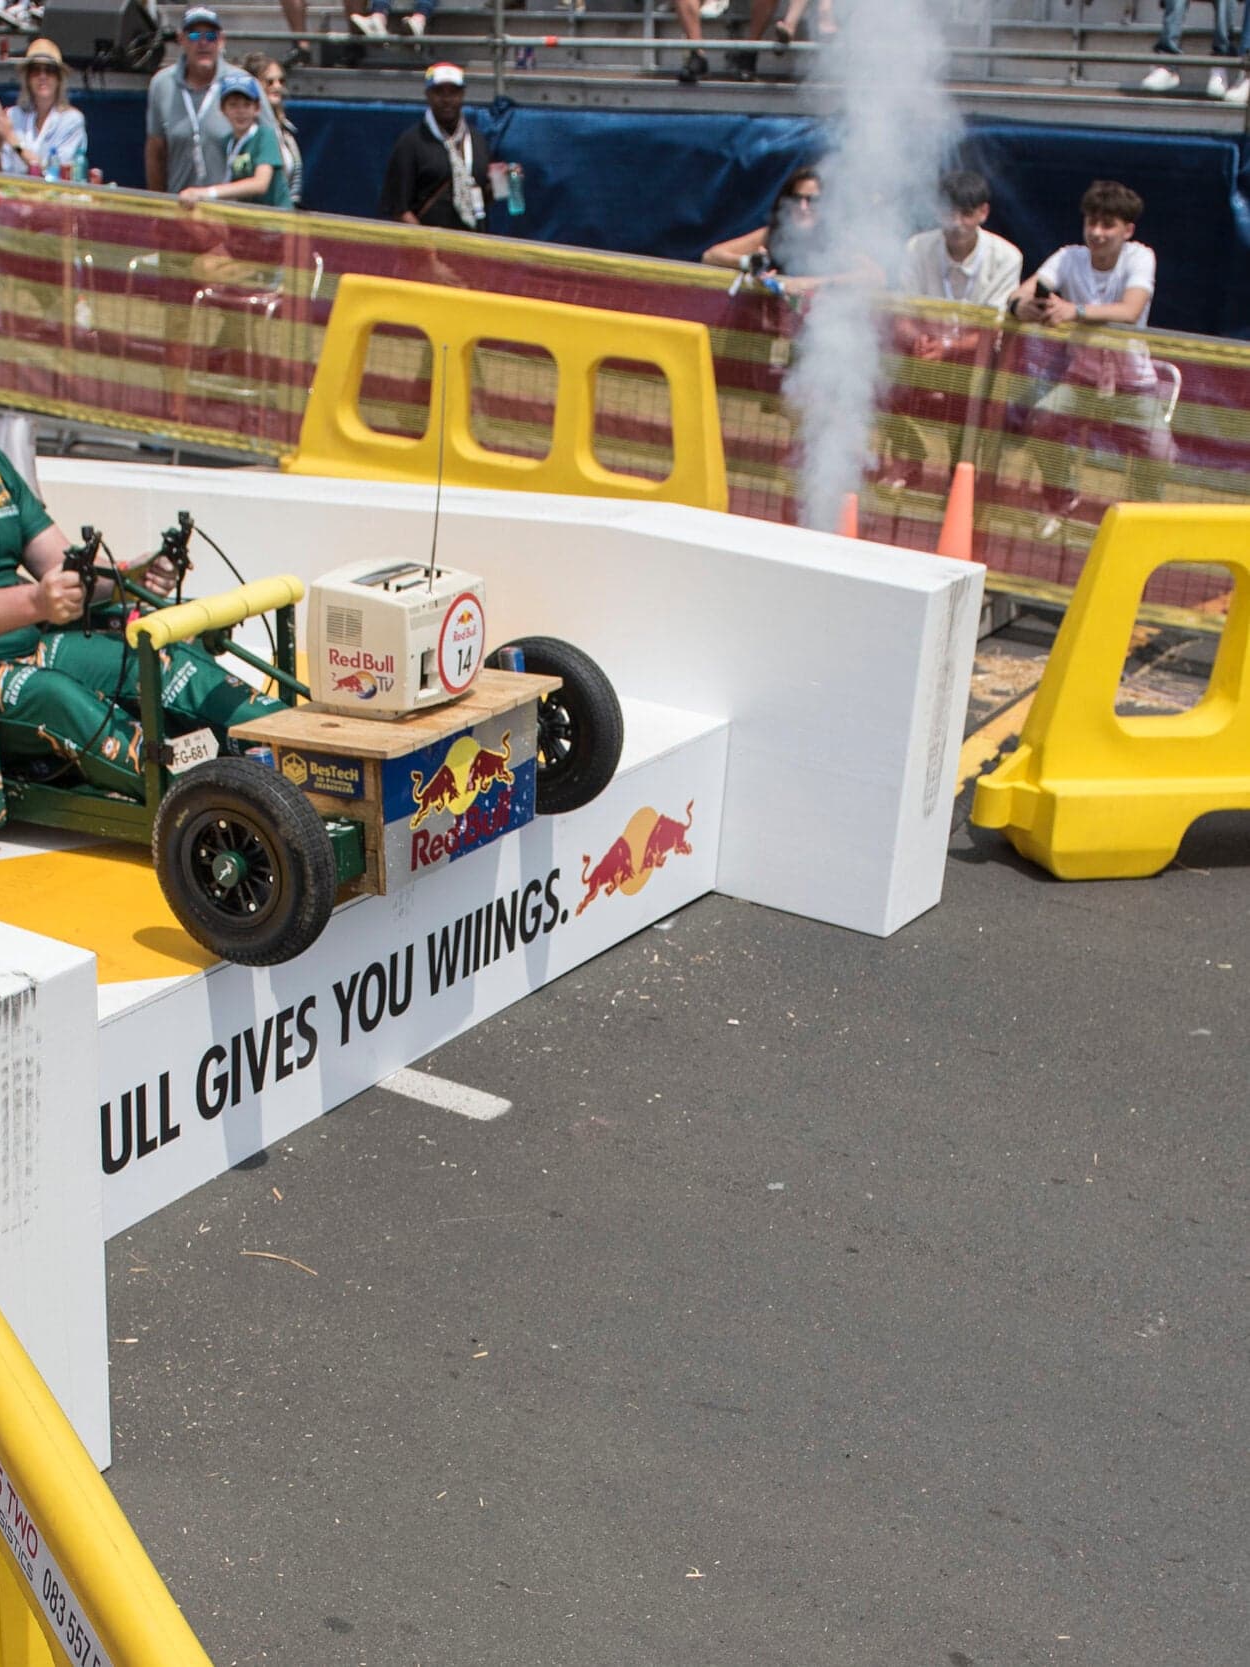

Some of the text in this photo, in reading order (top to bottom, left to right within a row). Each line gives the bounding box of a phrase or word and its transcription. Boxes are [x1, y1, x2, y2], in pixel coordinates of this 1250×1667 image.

[375, 675, 395, 692] TV
[457, 645, 473, 676] 14
[100, 868, 568, 1175] ULL GIVES YOU WIIINGS.
[7, 1482, 38, 1559] TWO
[43, 1568, 91, 1667] 083 557
